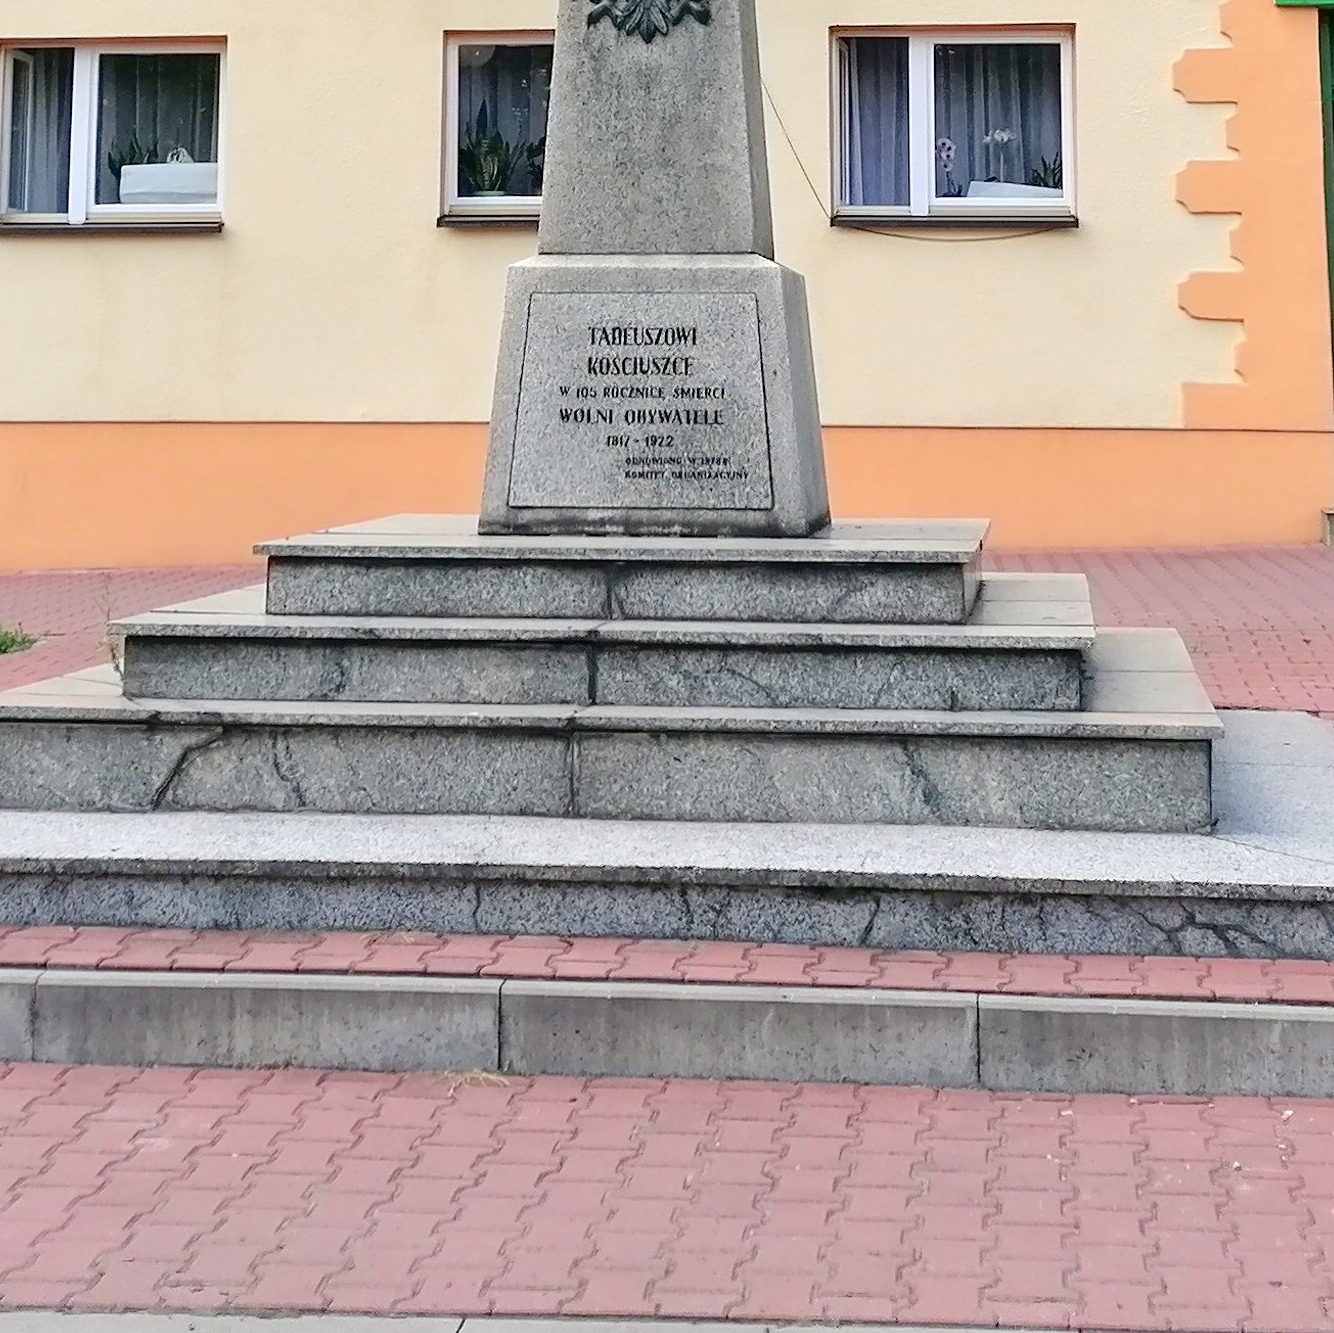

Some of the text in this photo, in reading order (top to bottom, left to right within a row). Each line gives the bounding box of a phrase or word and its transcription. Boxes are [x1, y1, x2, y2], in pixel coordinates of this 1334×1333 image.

[588, 327, 697, 346] TADEUSZOWI
[560, 386, 570, 397] W
[576, 387, 597, 399] 105
[559, 408, 724, 425] WOLNI OBYWATELE
[645, 435, 674, 447] 1922
